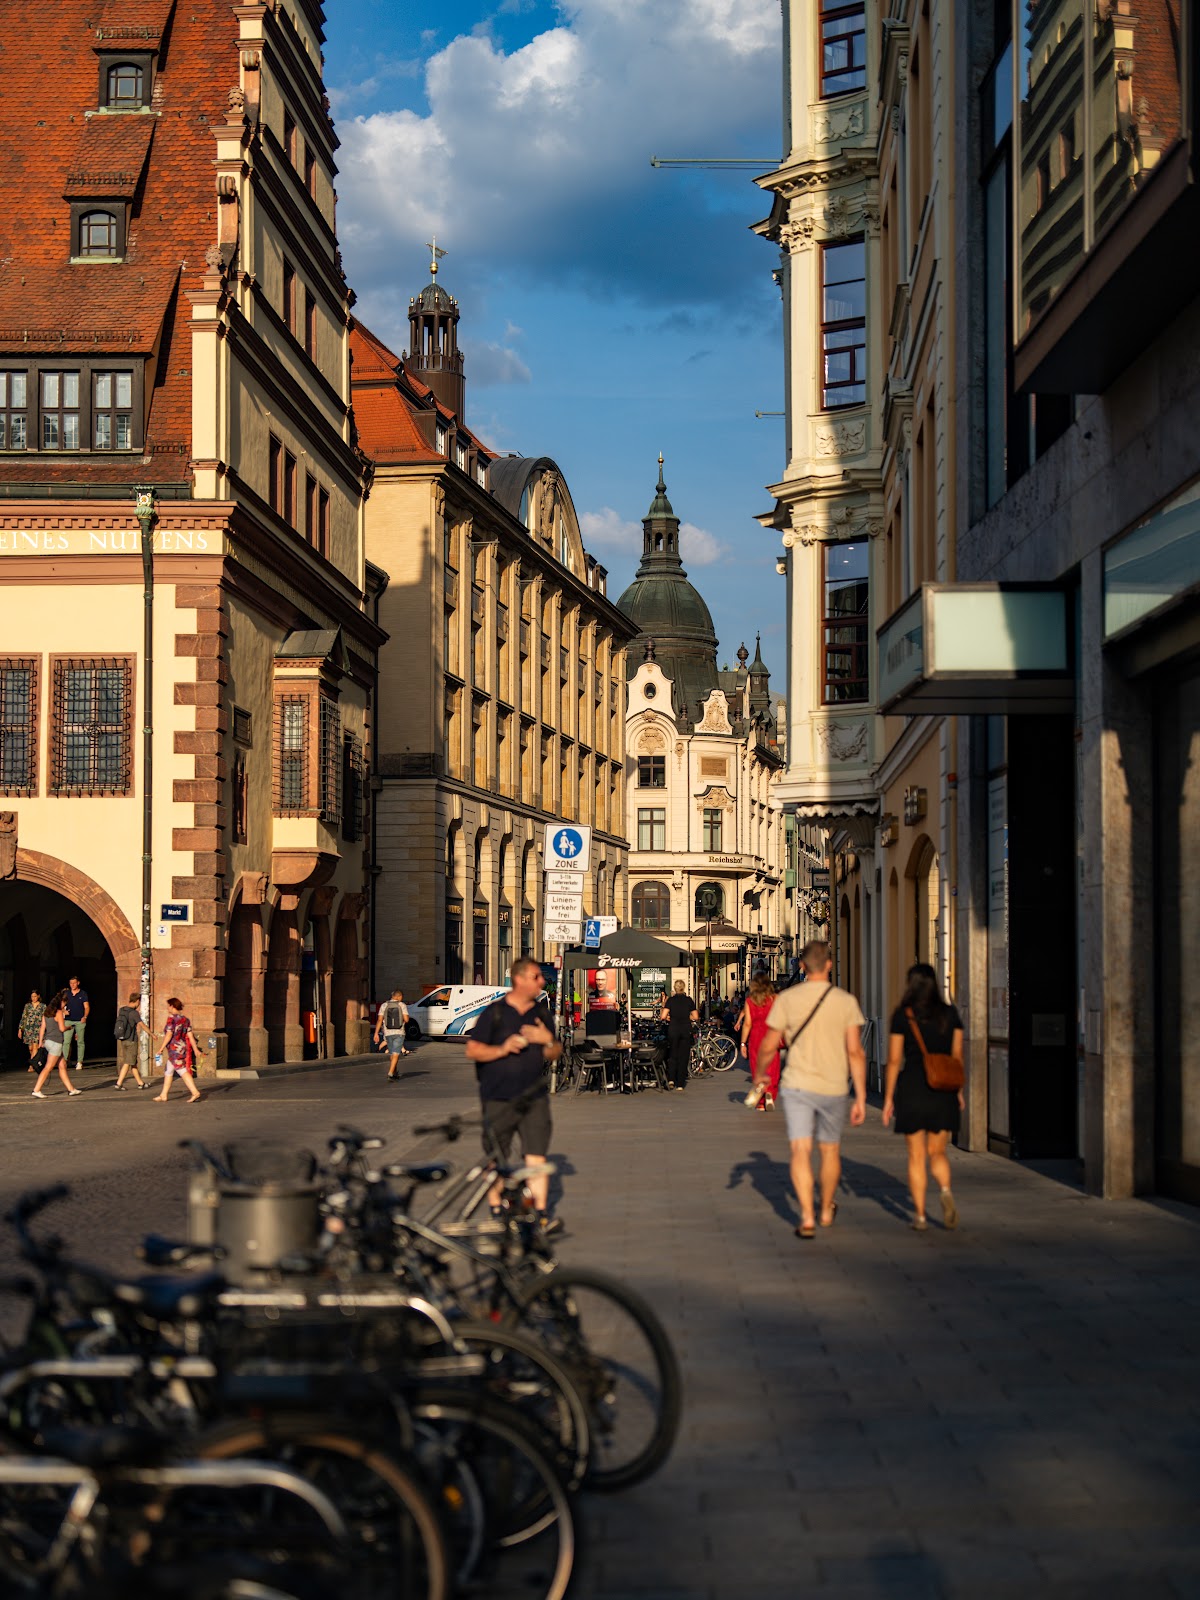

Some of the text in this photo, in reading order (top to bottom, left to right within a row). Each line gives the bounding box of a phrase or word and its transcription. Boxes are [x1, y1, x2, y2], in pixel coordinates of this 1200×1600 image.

[88, 531, 208, 549] NUTENS
[555, 860, 578, 868] ZONE
[708, 855, 743, 864] Reichshof
[610, 957, 643, 967] Tchibo
